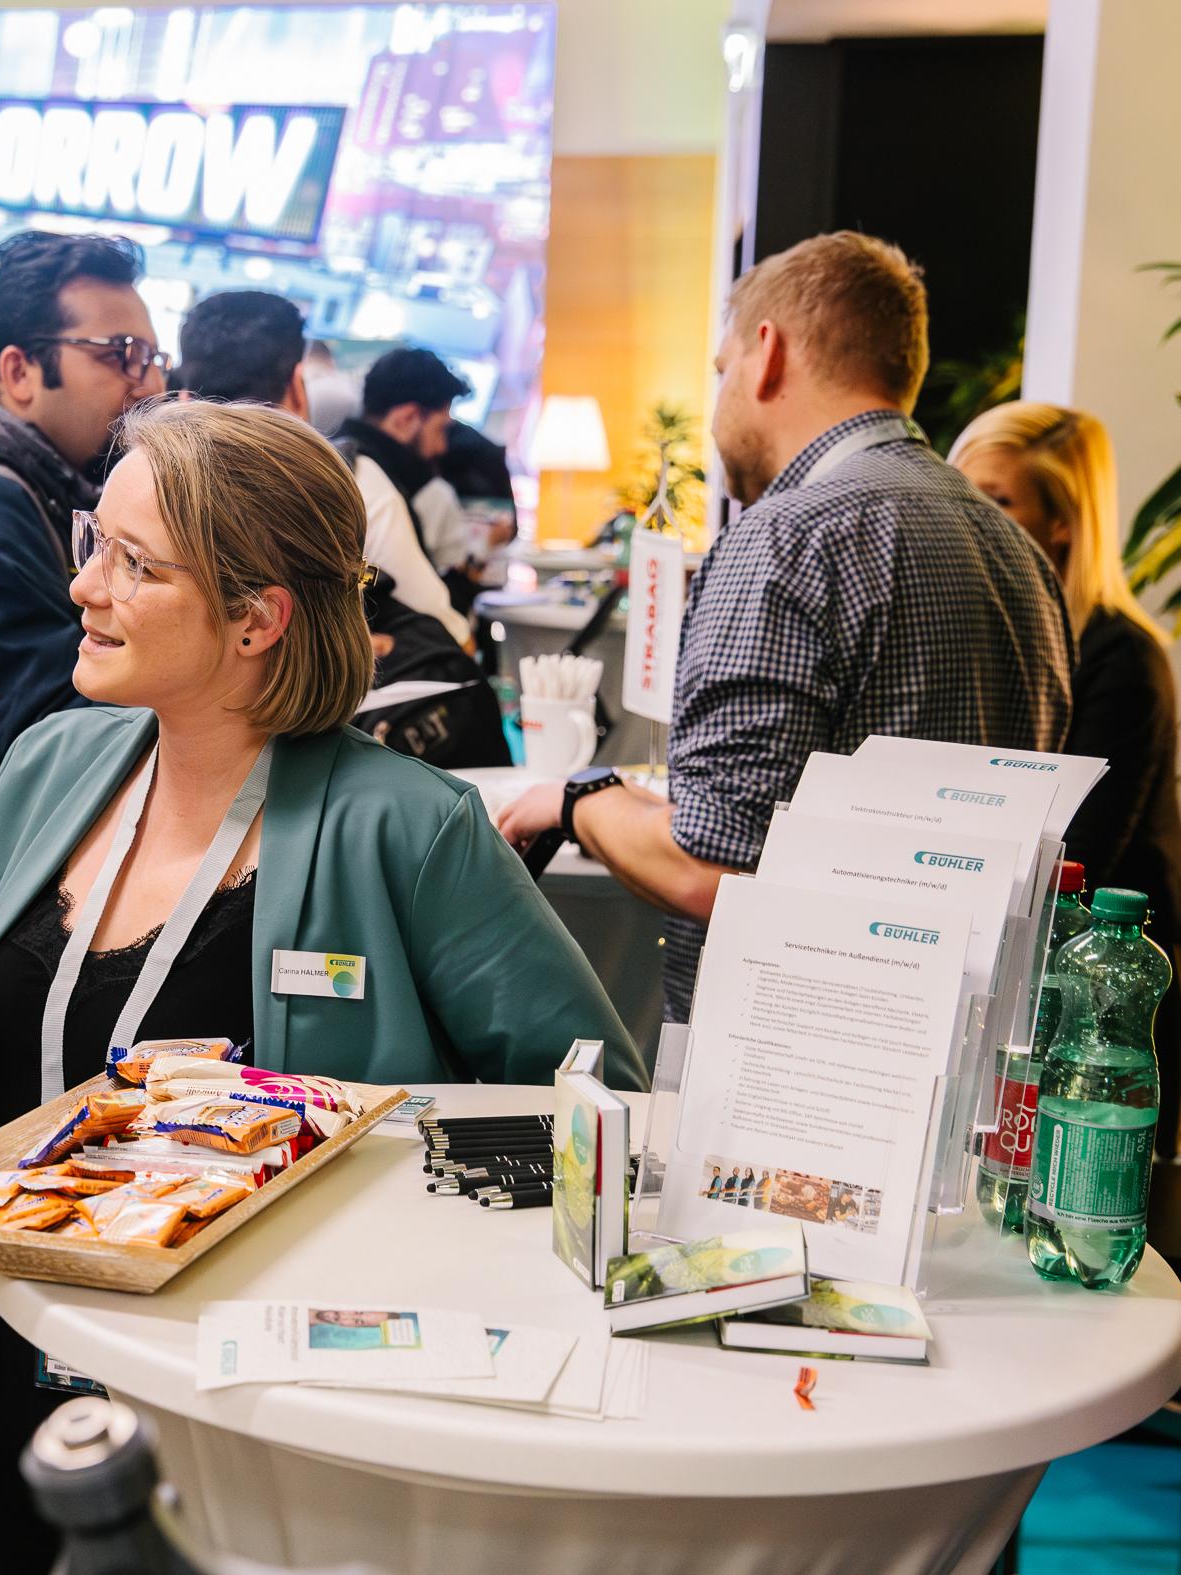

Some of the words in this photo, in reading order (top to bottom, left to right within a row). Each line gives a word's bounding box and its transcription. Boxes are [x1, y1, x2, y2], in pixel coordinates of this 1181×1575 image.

[641, 558, 660, 691] STRABAG
[1002, 760, 1059, 773] BÜHLER
[949, 790, 1007, 807] BÜHLER
[913, 811, 943, 825] (m/w/d)
[927, 855, 985, 873] BÜHLER
[831, 867, 917, 886] Automatisierungstechniker
[918, 878, 948, 891] (m/w/d)
[883, 926, 940, 946] BÜHLER
[784, 941, 837, 957] Servicetechniker
[838, 949, 848, 958] im
[848, 950, 890, 966] Außendienst
[890, 956, 921, 971] (m/w/d)
[300, 968, 329, 977] HALMER
[1048, 1177, 1057, 1207] RECYCLE
[1053, 1129, 1062, 1157] WIEDER
